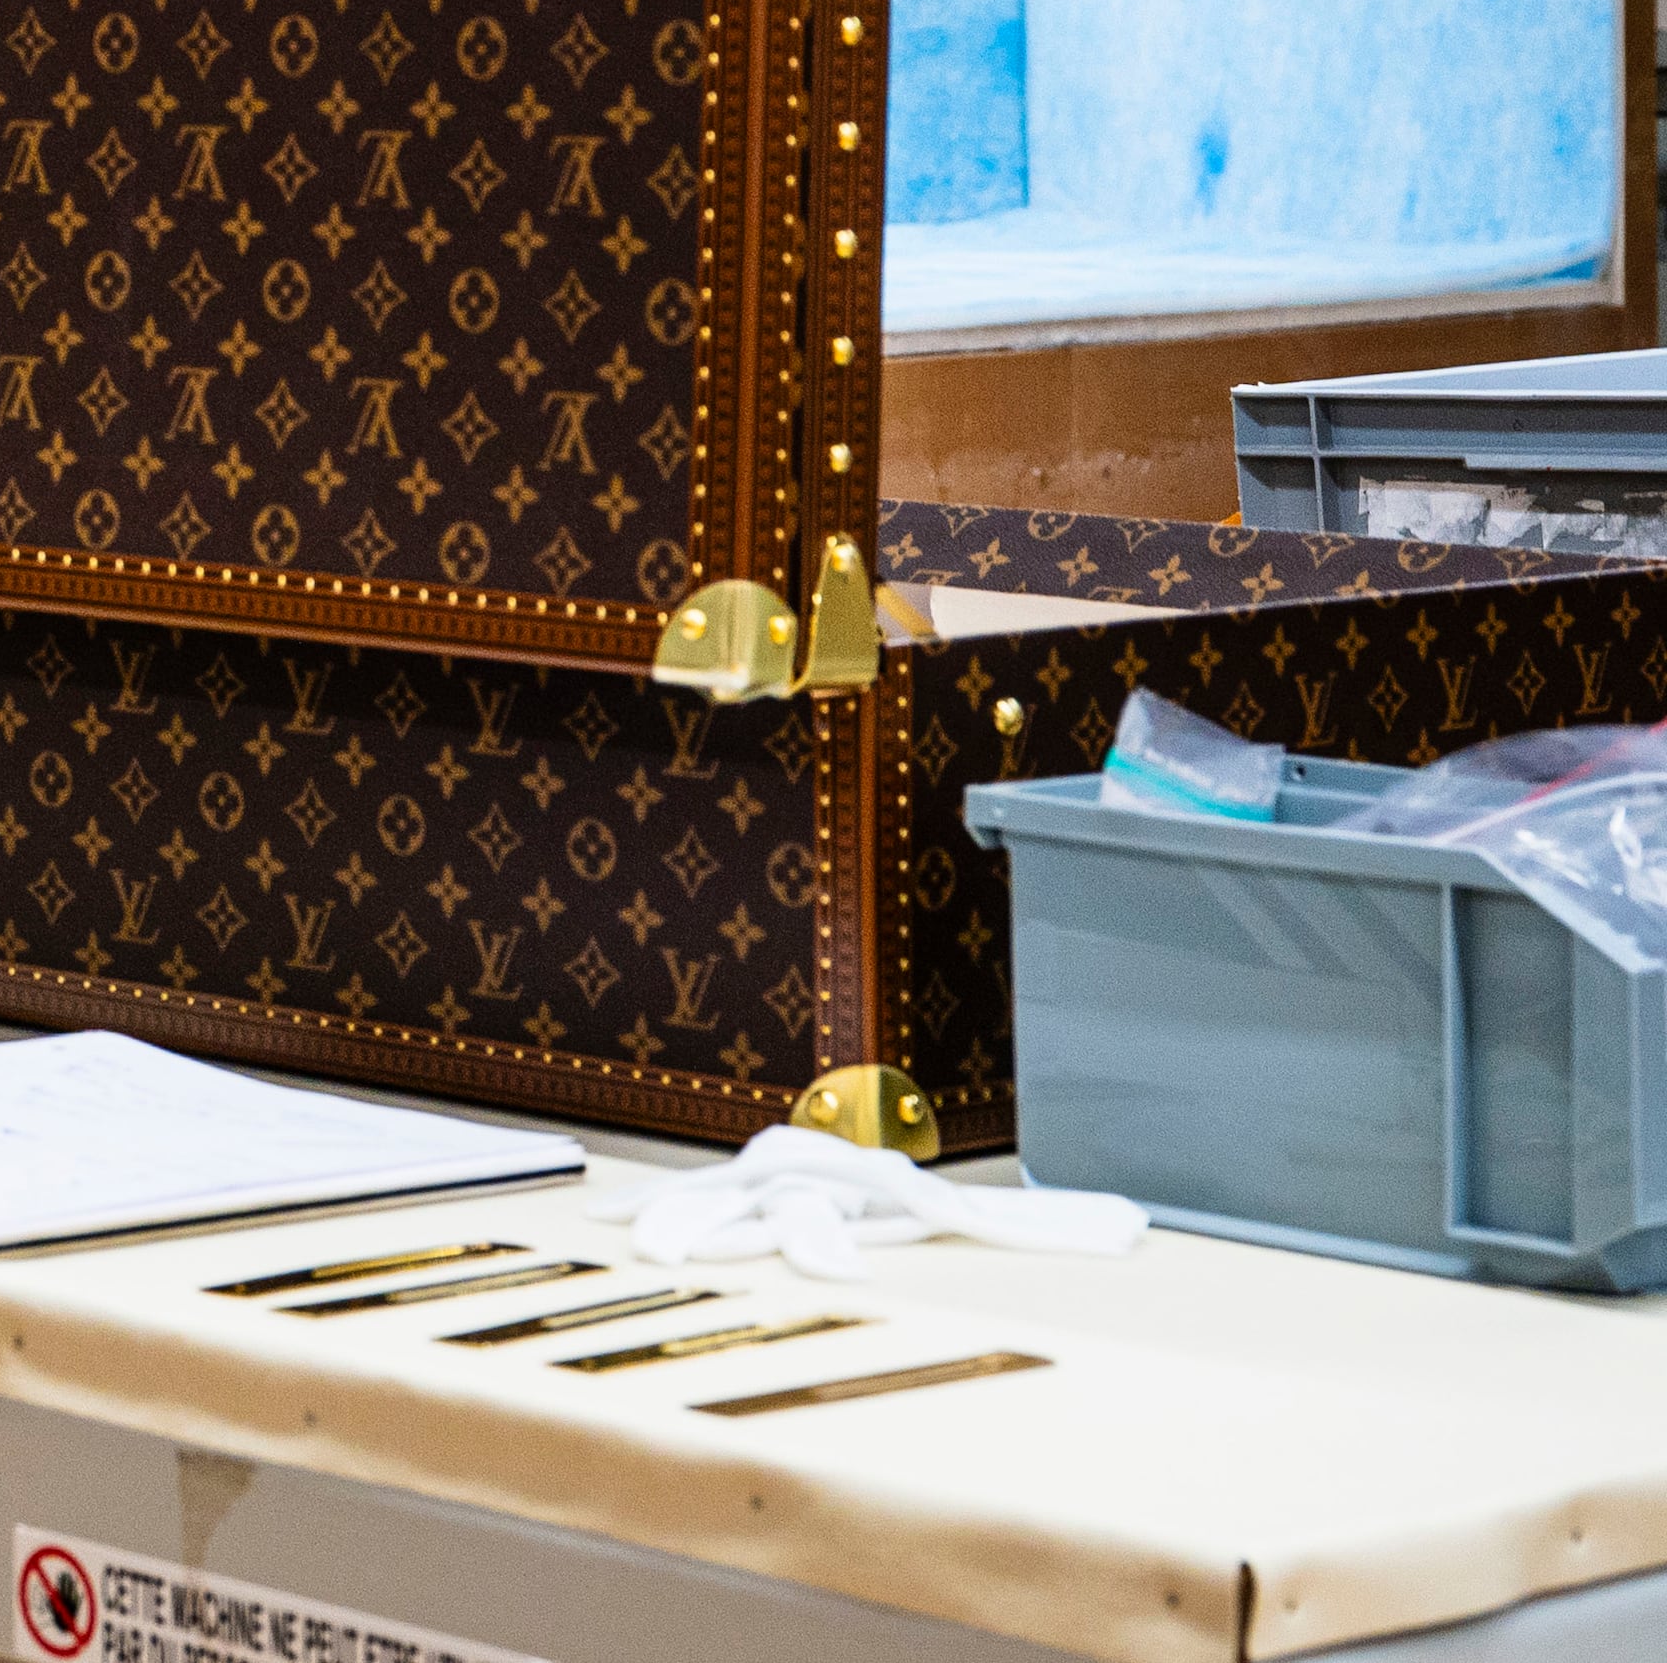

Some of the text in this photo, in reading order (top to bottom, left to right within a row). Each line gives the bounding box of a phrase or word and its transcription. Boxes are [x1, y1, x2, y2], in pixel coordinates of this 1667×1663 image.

[101, 1565, 164, 1626] CETTE
[170, 1584, 264, 1653] MACHINE
[269, 1606, 297, 1661] NE
